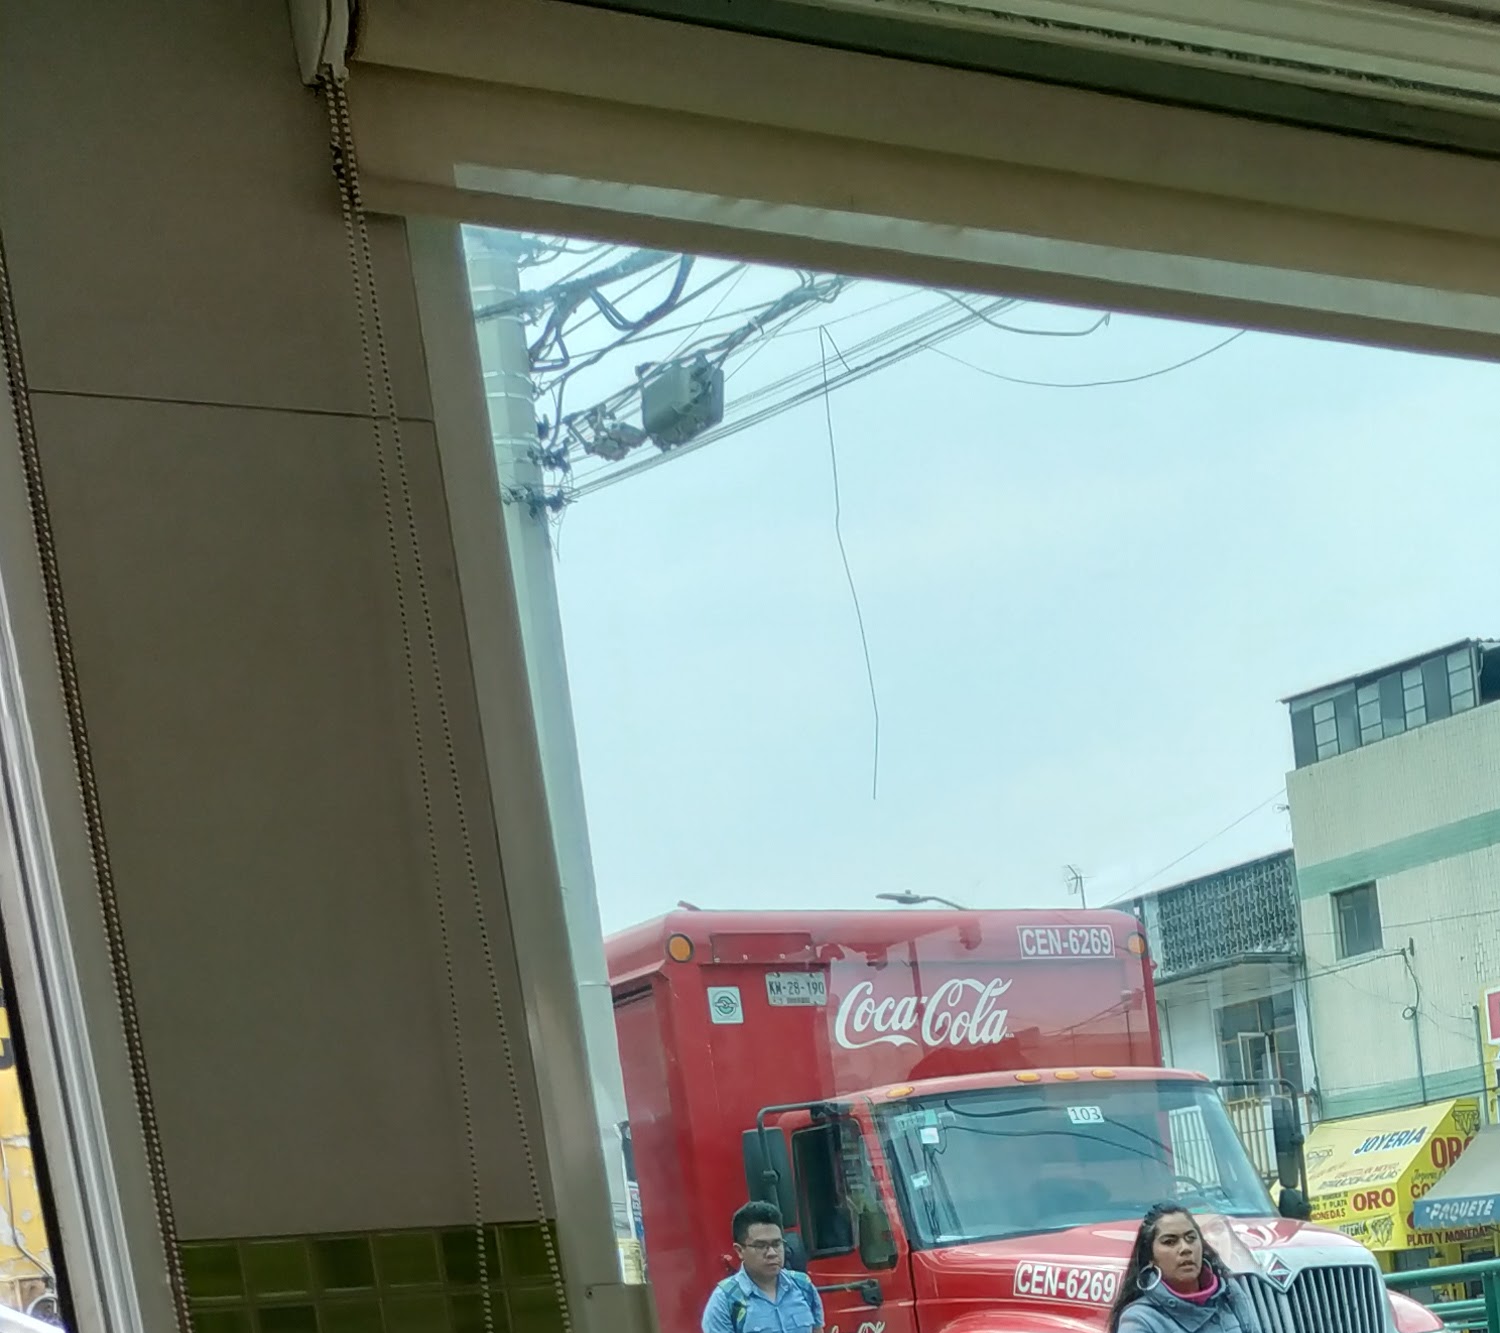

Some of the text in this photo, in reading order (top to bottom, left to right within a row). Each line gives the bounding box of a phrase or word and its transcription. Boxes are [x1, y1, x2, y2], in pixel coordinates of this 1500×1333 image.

[1021, 926, 1112, 956] CEN-6269
[834, 977, 1013, 1049] Coca-Cola
[1071, 1109, 1101, 1122] 103
[1353, 1126, 1428, 1155] JOYERIA
[1353, 1187, 1396, 1212] ORO
[1429, 1199, 1494, 1222] PAQUETE
[1406, 1232, 1434, 1247] PLATA
[1434, 1231, 1443, 1244] Y
[1016, 1263, 1116, 1303] CEN-6269
